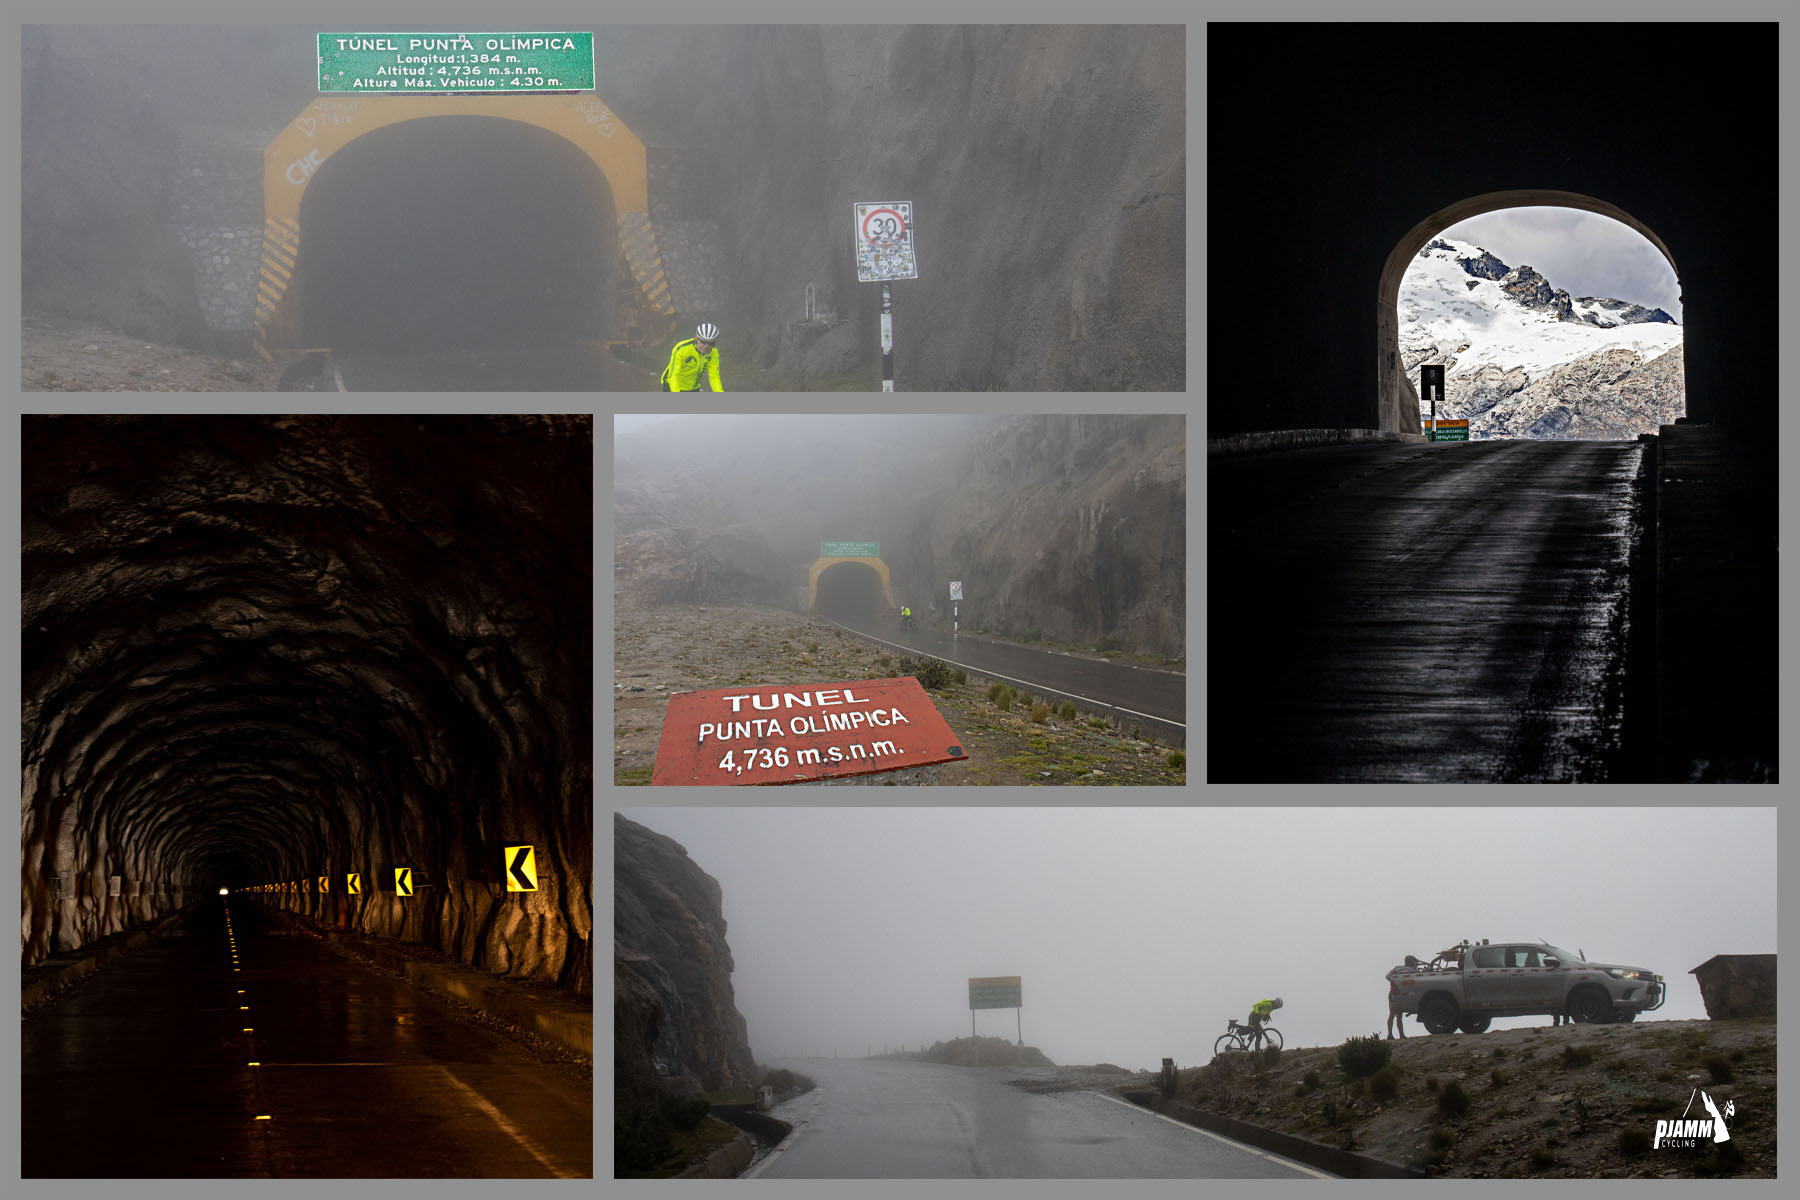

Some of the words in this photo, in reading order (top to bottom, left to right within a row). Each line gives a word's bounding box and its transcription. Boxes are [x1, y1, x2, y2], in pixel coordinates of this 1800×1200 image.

[336, 35, 398, 51] TÚNEL
[409, 39, 474, 51] PUNTA
[486, 35, 575, 50] OLÍMPICA
[506, 56, 521, 64] m.
[437, 66, 481, 77] 4,736
[488, 66, 542, 75] m.s.n.m.
[353, 78, 398, 88] Altura
[404, 77, 436, 87] Máx.
[510, 77, 544, 87] 4.30
[547, 78, 563, 86] m.
[872, 218, 897, 235] 30
[722, 688, 871, 713] TUNEL
[698, 718, 785, 742] PUNTA
[790, 707, 910, 736] OLÍMPICA
[718, 746, 789, 776] 4,736
[796, 738, 905, 766] m.s.n.m.
